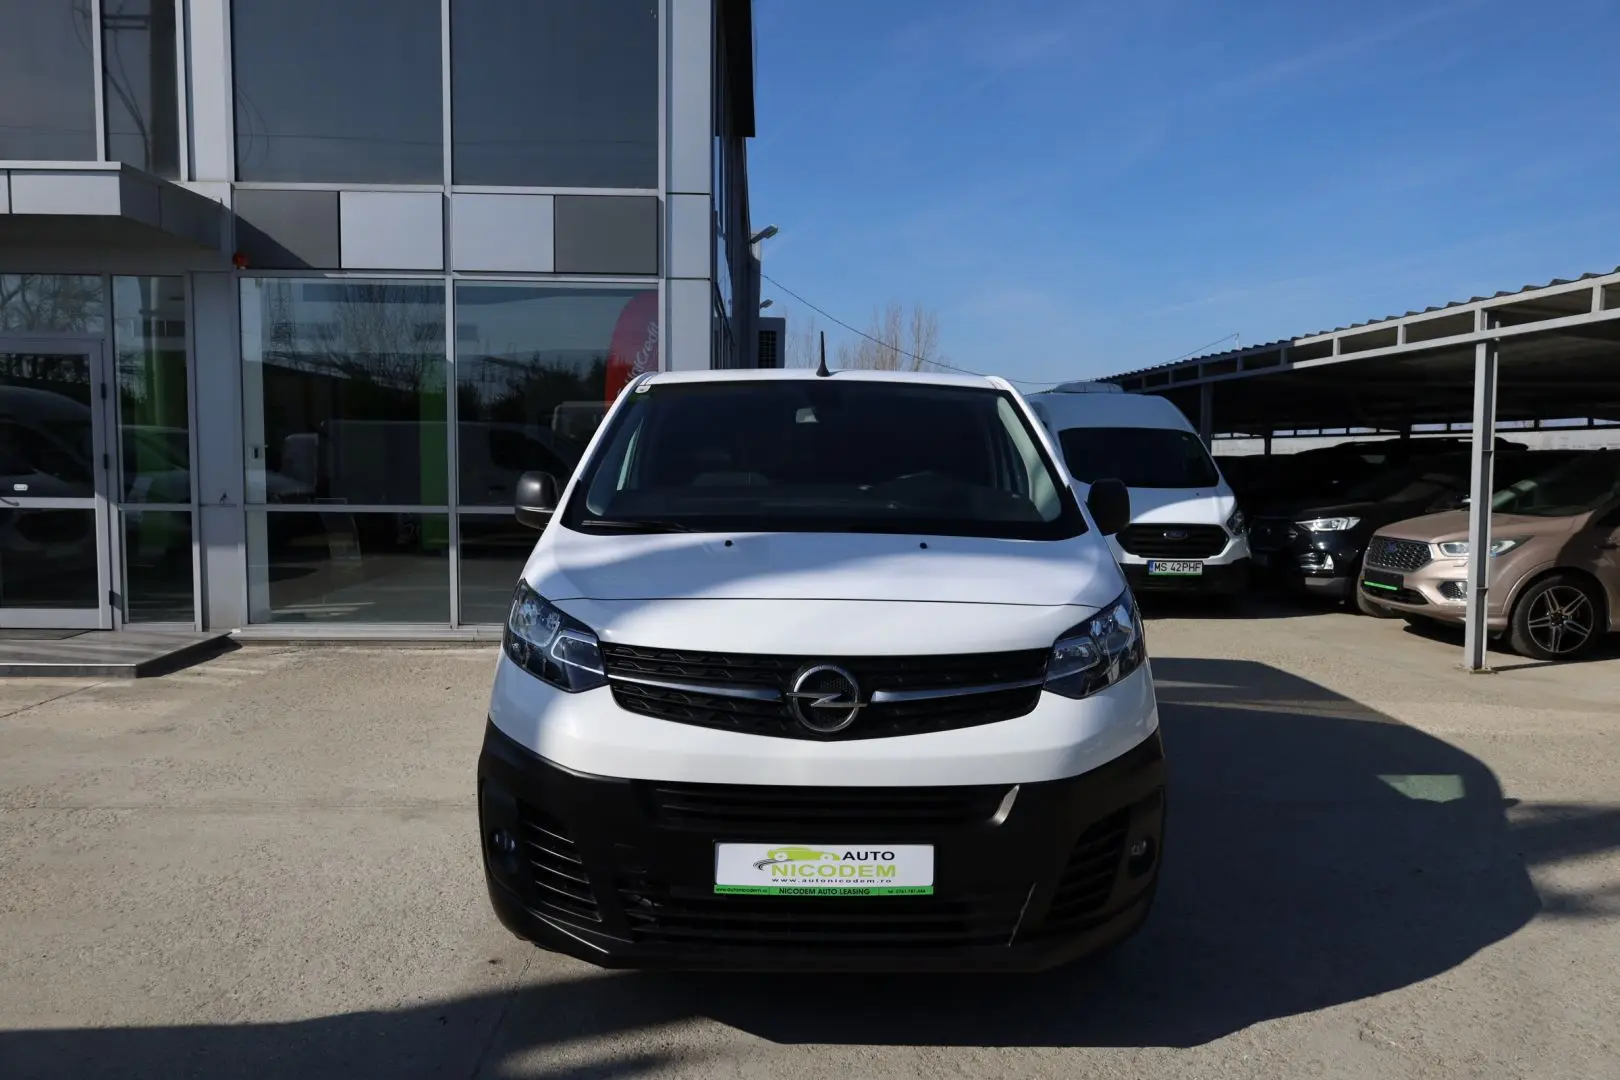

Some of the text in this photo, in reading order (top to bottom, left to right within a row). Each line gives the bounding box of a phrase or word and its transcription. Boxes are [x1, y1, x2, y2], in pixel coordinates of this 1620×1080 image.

[1154, 562, 1167, 571] MS
[842, 851, 895, 861] AUTO
[771, 863, 896, 877] NICODEM
[779, 887, 816, 895] NICODEM
